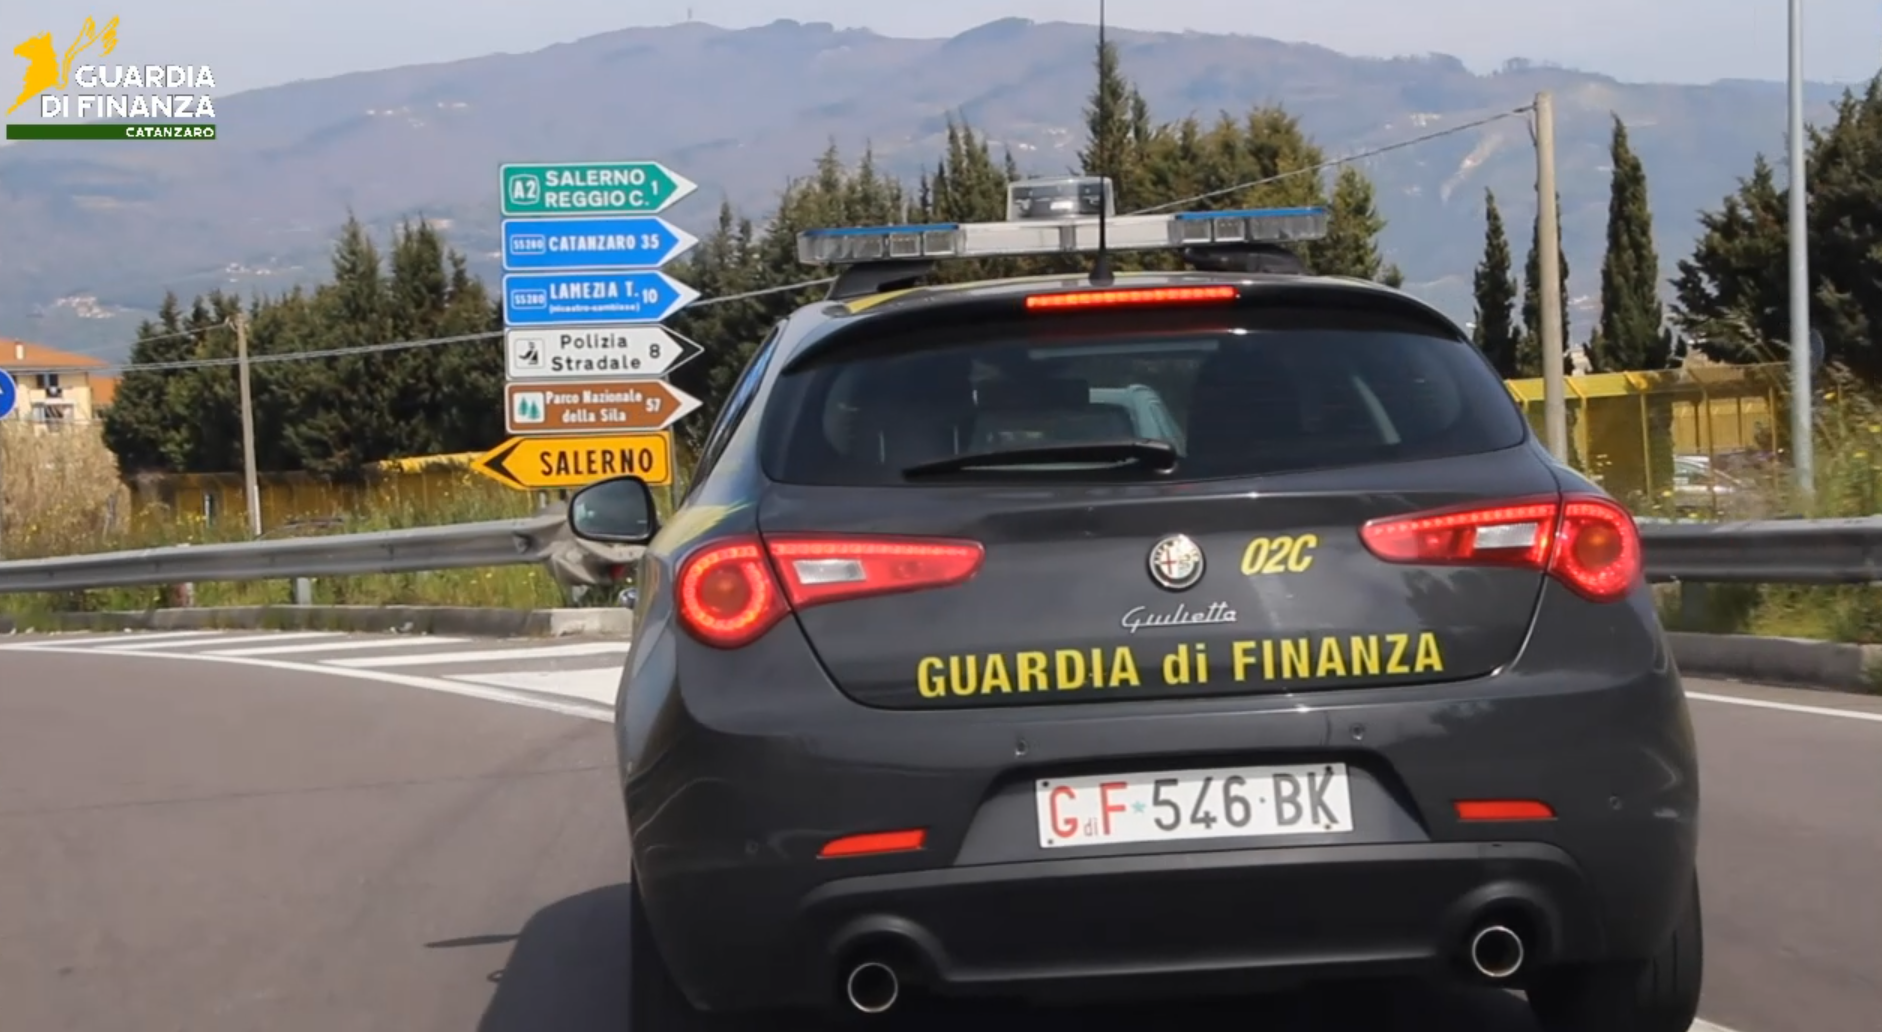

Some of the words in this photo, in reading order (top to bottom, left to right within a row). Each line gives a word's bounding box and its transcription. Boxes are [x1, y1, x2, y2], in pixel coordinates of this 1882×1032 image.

[545, 169, 645, 187] SALERNO
[513, 180, 536, 199] A2
[651, 180, 658, 196] 1
[545, 190, 626, 208] REGGIO
[629, 190, 649, 207] C.
[549, 234, 636, 252] CATANZARO
[641, 234, 660, 250] 35
[550, 281, 618, 300] LAMEZIA
[625, 280, 639, 298] T.
[642, 288, 658, 304] 10
[560, 333, 628, 349] Polizia
[649, 343, 661, 359] 8
[551, 355, 641, 372] Stradale
[546, 390, 579, 405] Parco
[583, 388, 642, 404] Nazionale
[646, 397, 661, 412] 57
[562, 409, 596, 423] della
[601, 408, 627, 422] Sila
[540, 448, 654, 476] SALERNO
[1240, 534, 1318, 576] 02C
[1121, 601, 1237, 634] Giulietta
[916, 646, 1140, 698] GUARDIA
[1162, 643, 1207, 686] di
[1232, 632, 1444, 683] FINANZA
